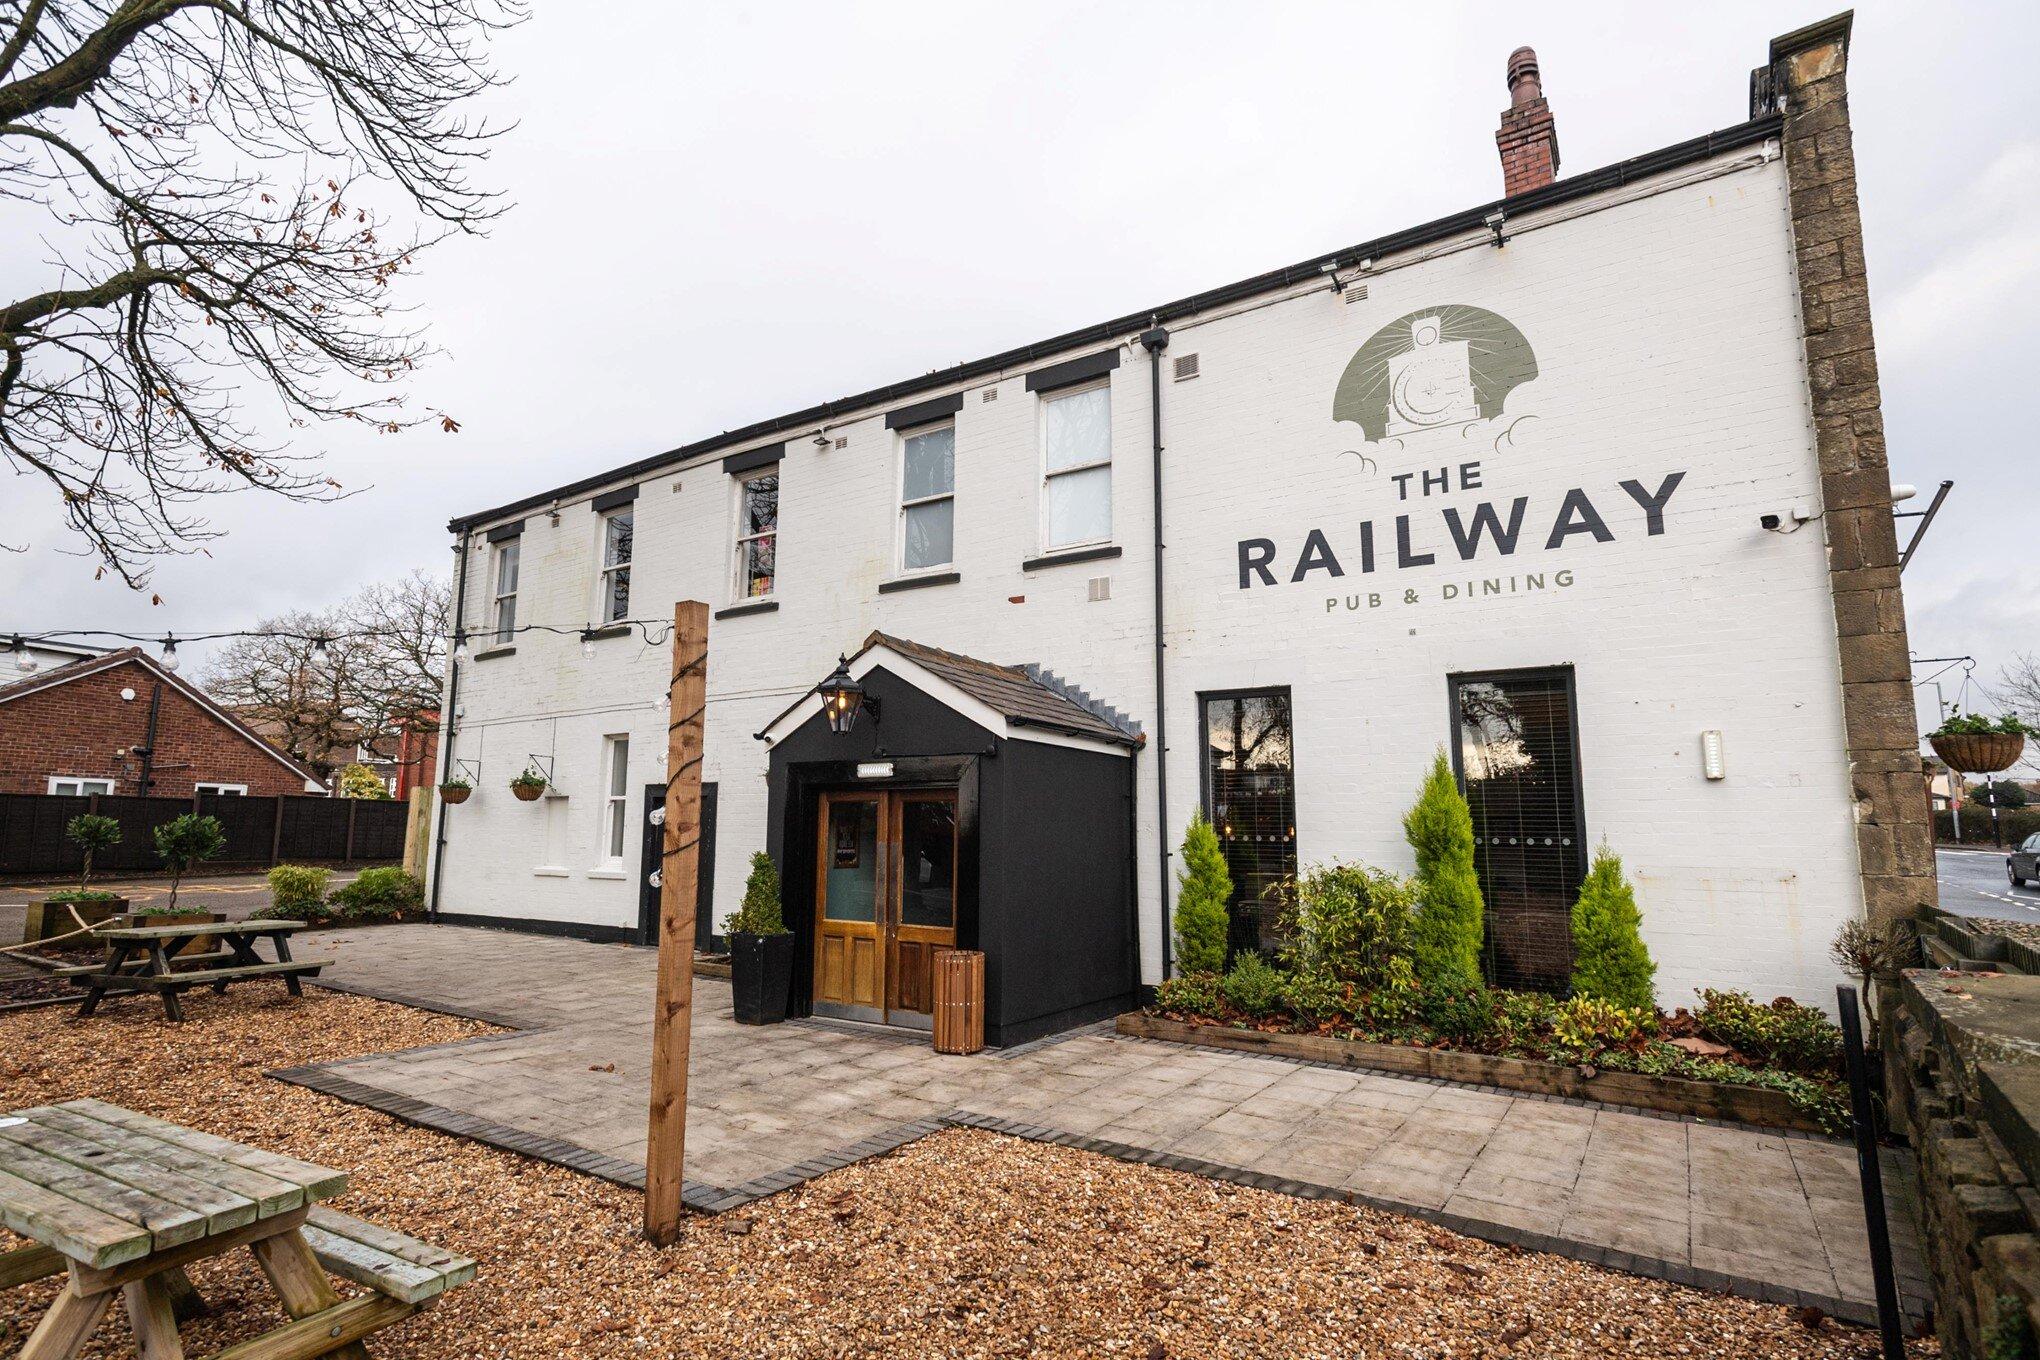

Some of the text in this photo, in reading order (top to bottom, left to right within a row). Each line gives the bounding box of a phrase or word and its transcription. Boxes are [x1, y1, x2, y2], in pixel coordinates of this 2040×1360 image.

[1391, 461, 1483, 501] THE
[1237, 471, 1688, 590] RAILWAY
[1325, 569, 1574, 613] PUB & DINING
